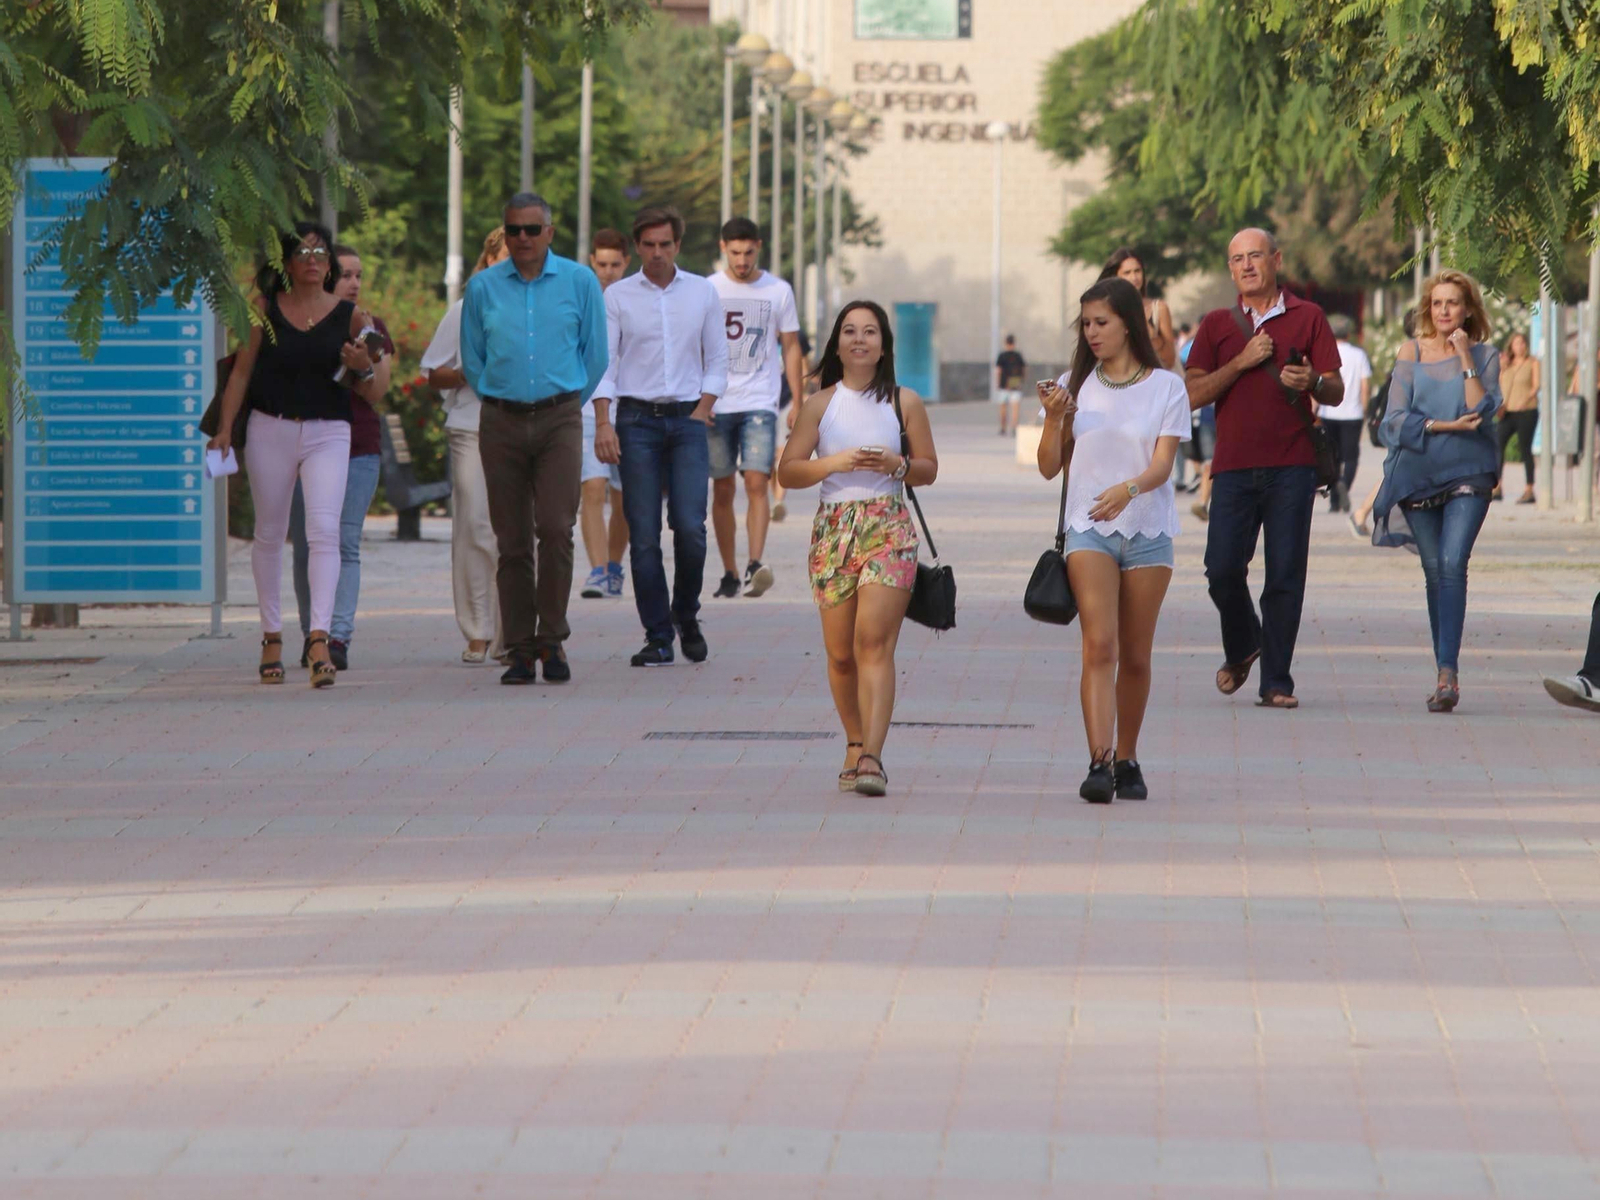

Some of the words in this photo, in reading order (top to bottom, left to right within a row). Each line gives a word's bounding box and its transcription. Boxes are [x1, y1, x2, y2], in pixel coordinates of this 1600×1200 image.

[853, 61, 970, 84] ESCUELA
[853, 91, 977, 113] SUPERIOR
[29, 300, 44, 312] 18
[29, 325, 44, 337] 19
[725, 311, 744, 340] 5
[746, 327, 764, 358] 7
